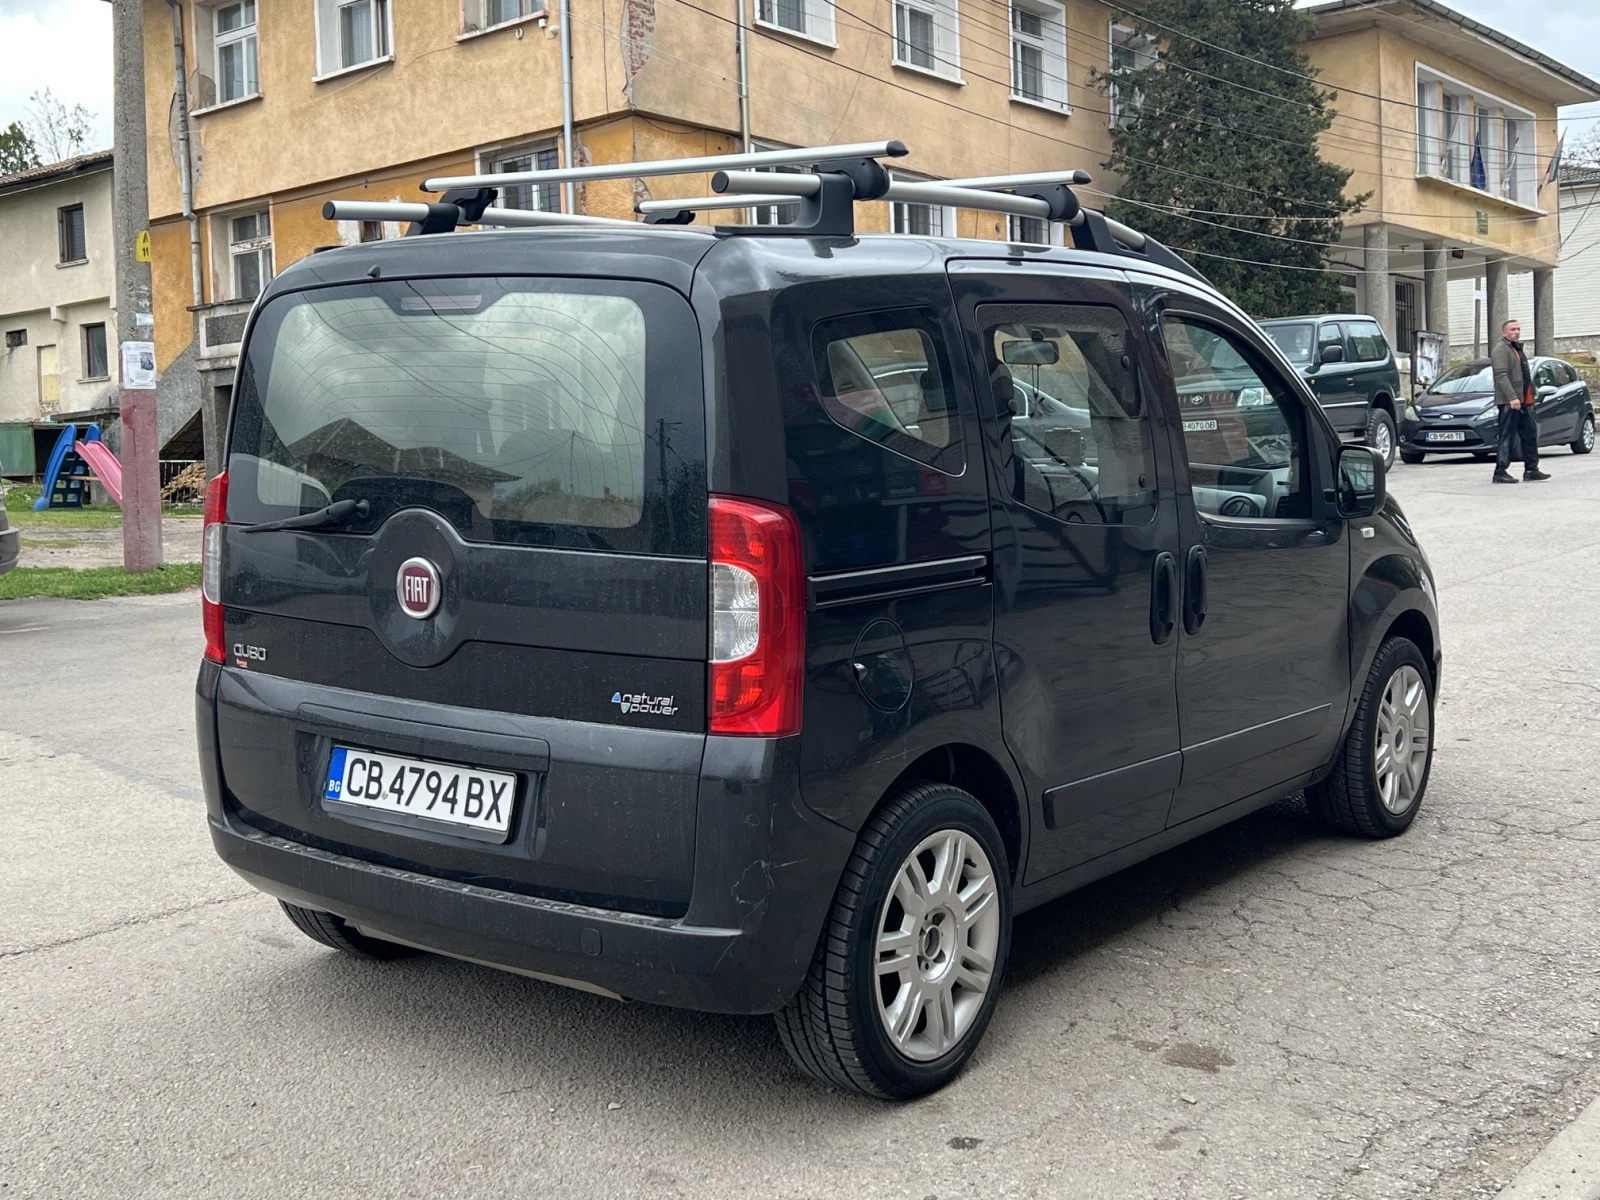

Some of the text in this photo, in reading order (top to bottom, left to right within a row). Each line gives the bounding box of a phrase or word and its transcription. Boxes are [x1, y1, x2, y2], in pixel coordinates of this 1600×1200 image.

[405, 575, 429, 603] FIAT
[233, 643, 267, 661] QUBO
[622, 692, 675, 706] natural
[629, 703, 679, 716] power
[328, 779, 341, 793] BG
